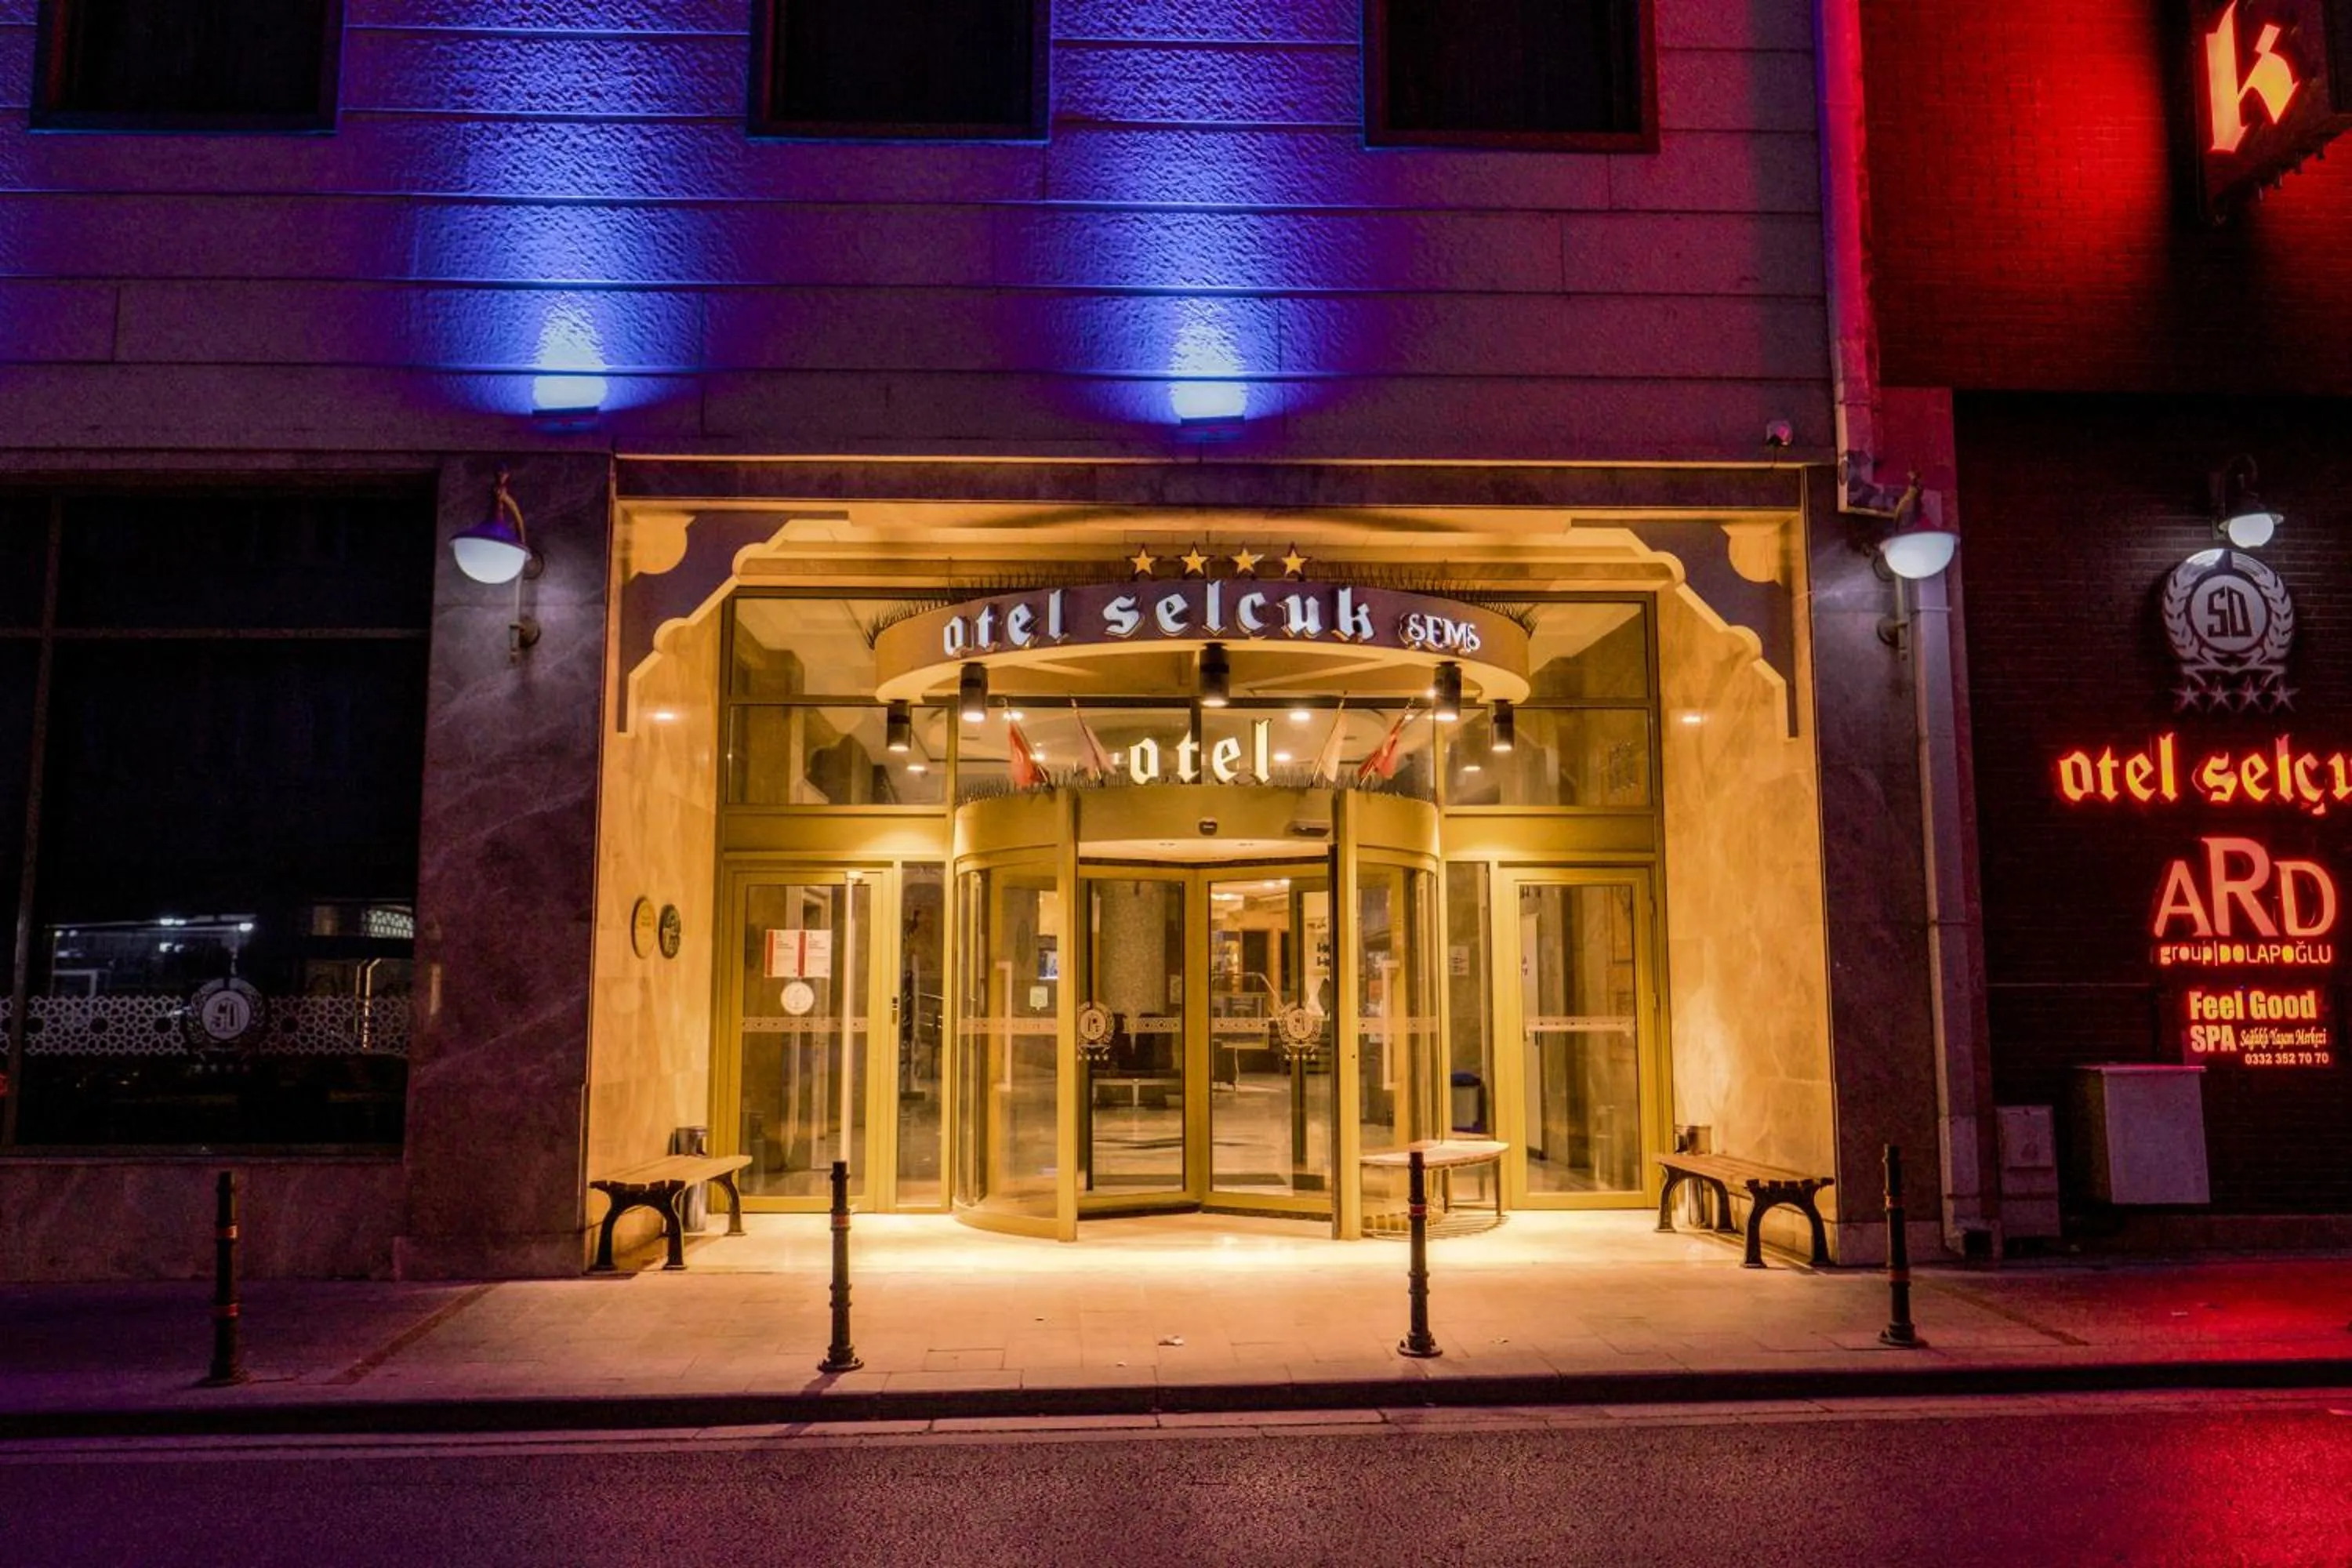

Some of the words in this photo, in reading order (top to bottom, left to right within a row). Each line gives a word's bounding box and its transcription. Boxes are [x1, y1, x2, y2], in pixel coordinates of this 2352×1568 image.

[943, 588, 1068, 657] otel
[1129, 718, 1273, 785] otel
[2058, 732, 2178, 802] otel
[2154, 837, 2336, 938] ARD
[2189, 991, 2245, 1020] Feel
[2250, 990, 2318, 1020] Good
[2190, 1025, 2237, 1053] SPA
[2298, 1052, 2313, 1065] 70
[2314, 1052, 2329, 1064] 70
